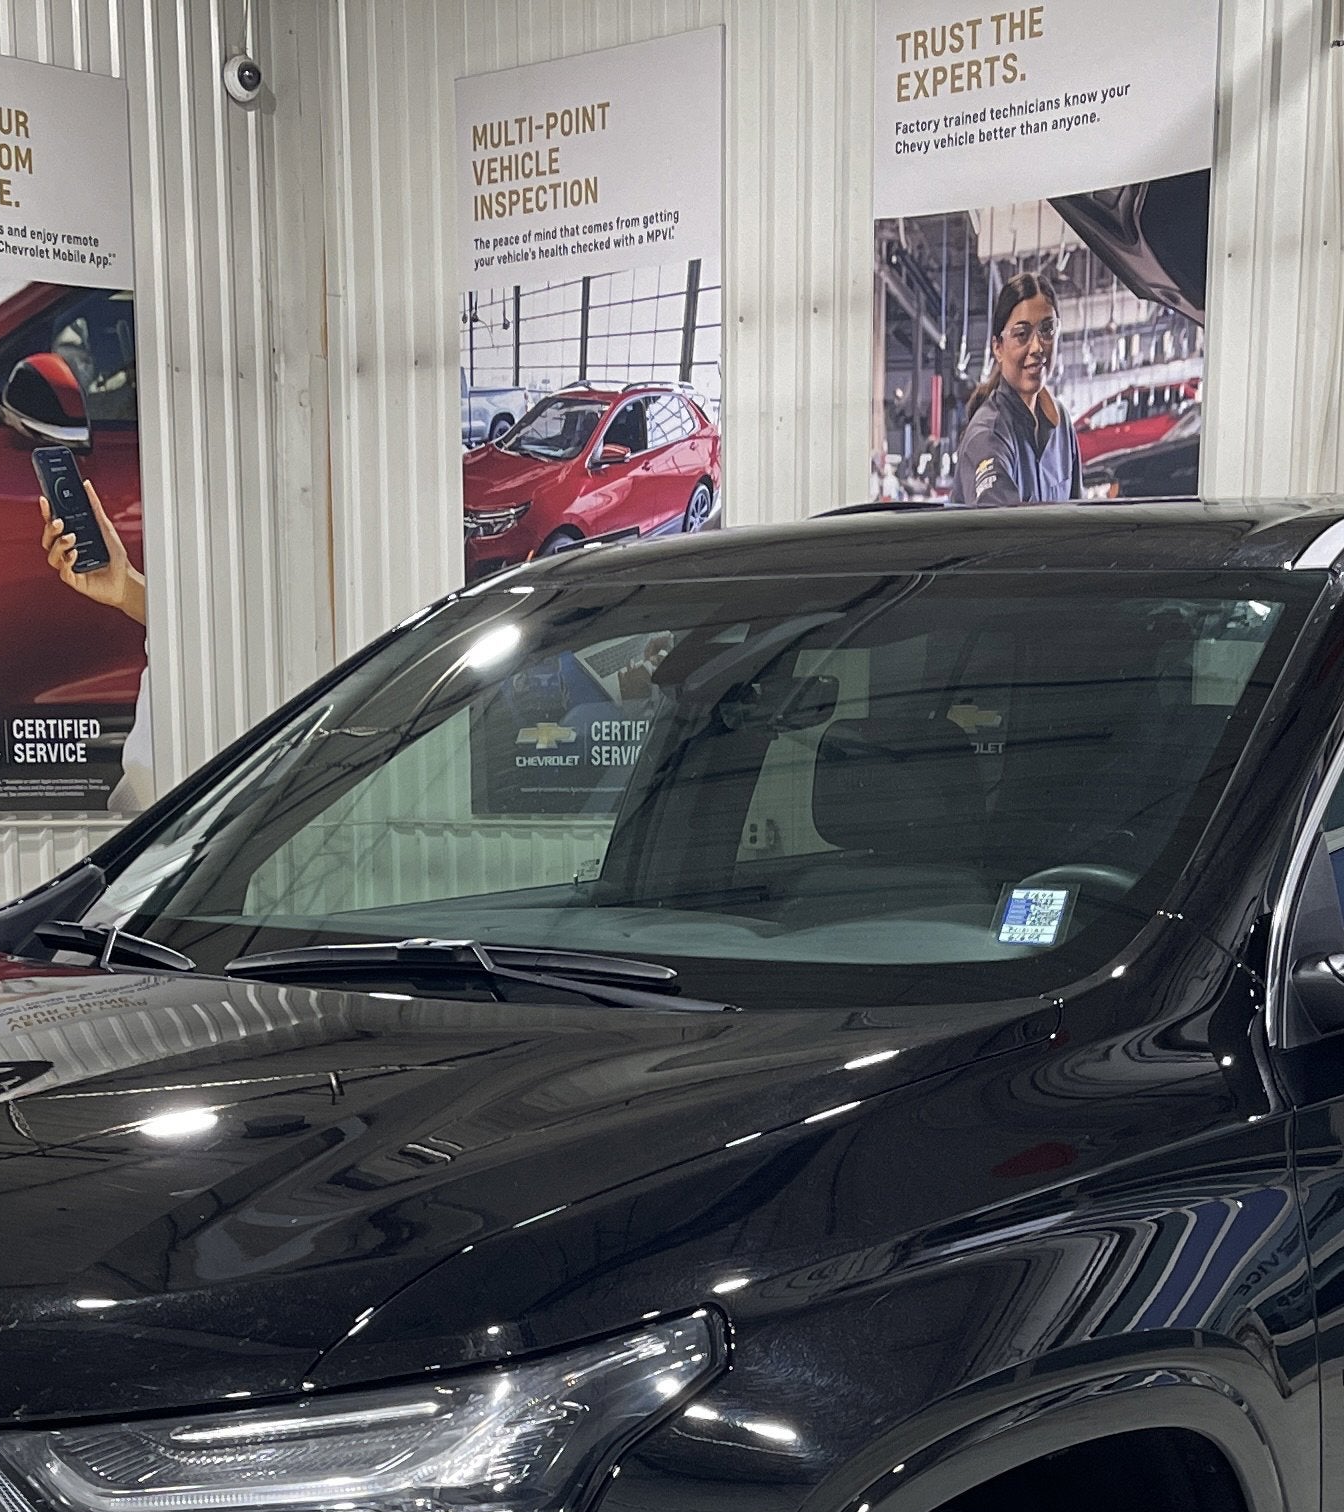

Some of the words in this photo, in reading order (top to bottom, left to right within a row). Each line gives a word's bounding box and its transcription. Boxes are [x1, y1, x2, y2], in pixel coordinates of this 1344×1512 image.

[896, 18, 983, 64] TRUST
[991, 5, 1044, 46] THE
[896, 52, 1026, 103] EXPERTS.
[472, 101, 610, 152] MULTI-POINT
[895, 119, 940, 137] Factory
[943, 107, 986, 130] trained
[990, 97, 1061, 121] technicians
[1064, 89, 1097, 107] know
[1100, 83, 1131, 103] your
[895, 136, 930, 155] Chevy
[933, 131, 975, 150] vehicle
[978, 124, 1017, 142] better
[1020, 120, 1048, 136] than
[1052, 111, 1101, 132] anyone.
[472, 147, 560, 186] VEHICLE
[474, 176, 598, 222] INSPECTION
[7, 224, 27, 239] and
[30, 228, 58, 245] enjoy
[61, 233, 99, 248] remote
[474, 238, 490, 250] The
[493, 235, 520, 252] peace
[522, 232, 532, 244] of
[534, 226, 557, 242] mind
[560, 224, 580, 238] that
[582, 221, 614, 235] comes
[616, 216, 640, 229] from
[642, 209, 680, 227] getting
[53, 247, 86, 264] Mobile
[474, 256, 495, 271] your
[497, 247, 537, 265] vehicle's
[538, 244, 569, 259] health
[571, 239, 611, 255] checked
[613, 235, 636, 248] with
[638, 235, 644, 244] a
[12, 719, 100, 739] CERTIFIED
[14, 743, 87, 763] SERVICE
[515, 755, 580, 767] CHEVROLET
